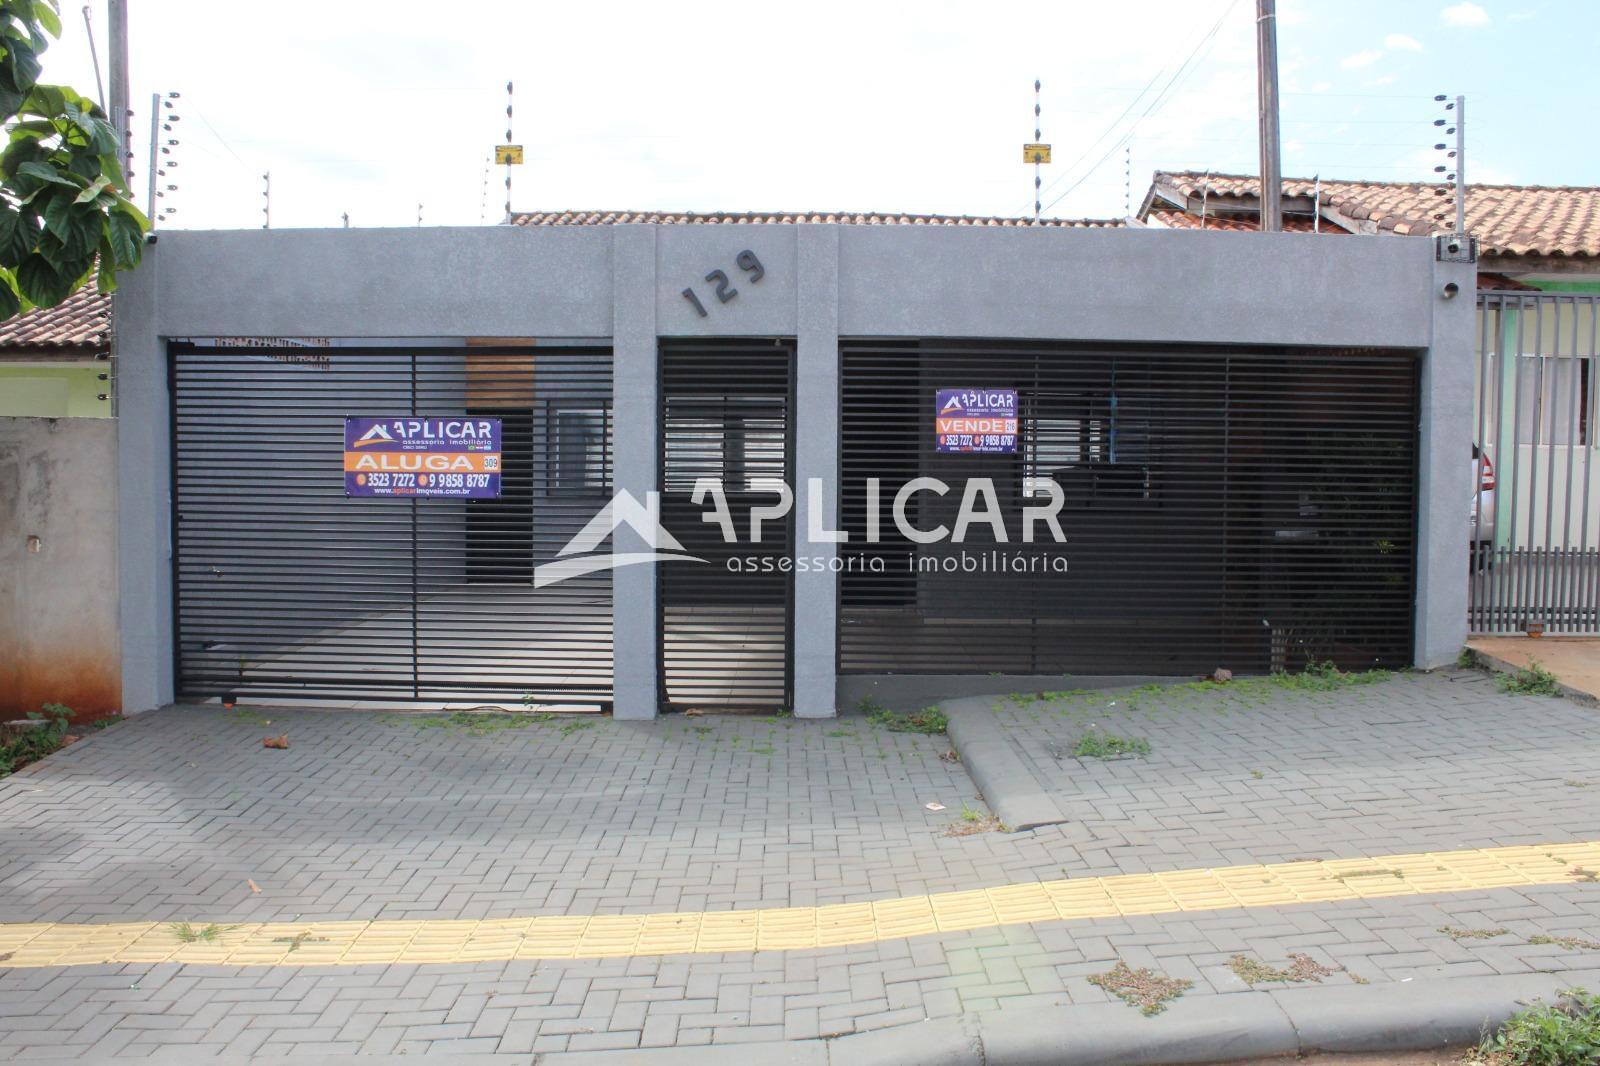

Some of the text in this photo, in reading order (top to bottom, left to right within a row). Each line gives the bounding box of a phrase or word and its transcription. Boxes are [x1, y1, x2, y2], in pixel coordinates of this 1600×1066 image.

[682, 249, 765, 318] 129
[962, 393, 1013, 407] APLICAR
[393, 421, 492, 438] APLICAR
[940, 420, 1003, 432] VENDE
[946, 434, 959, 446] 3523
[960, 434, 973, 446] 7272
[355, 454, 498, 470] ALUGA 309
[367, 472, 490, 488] 3523 7272 9 9858 8787
